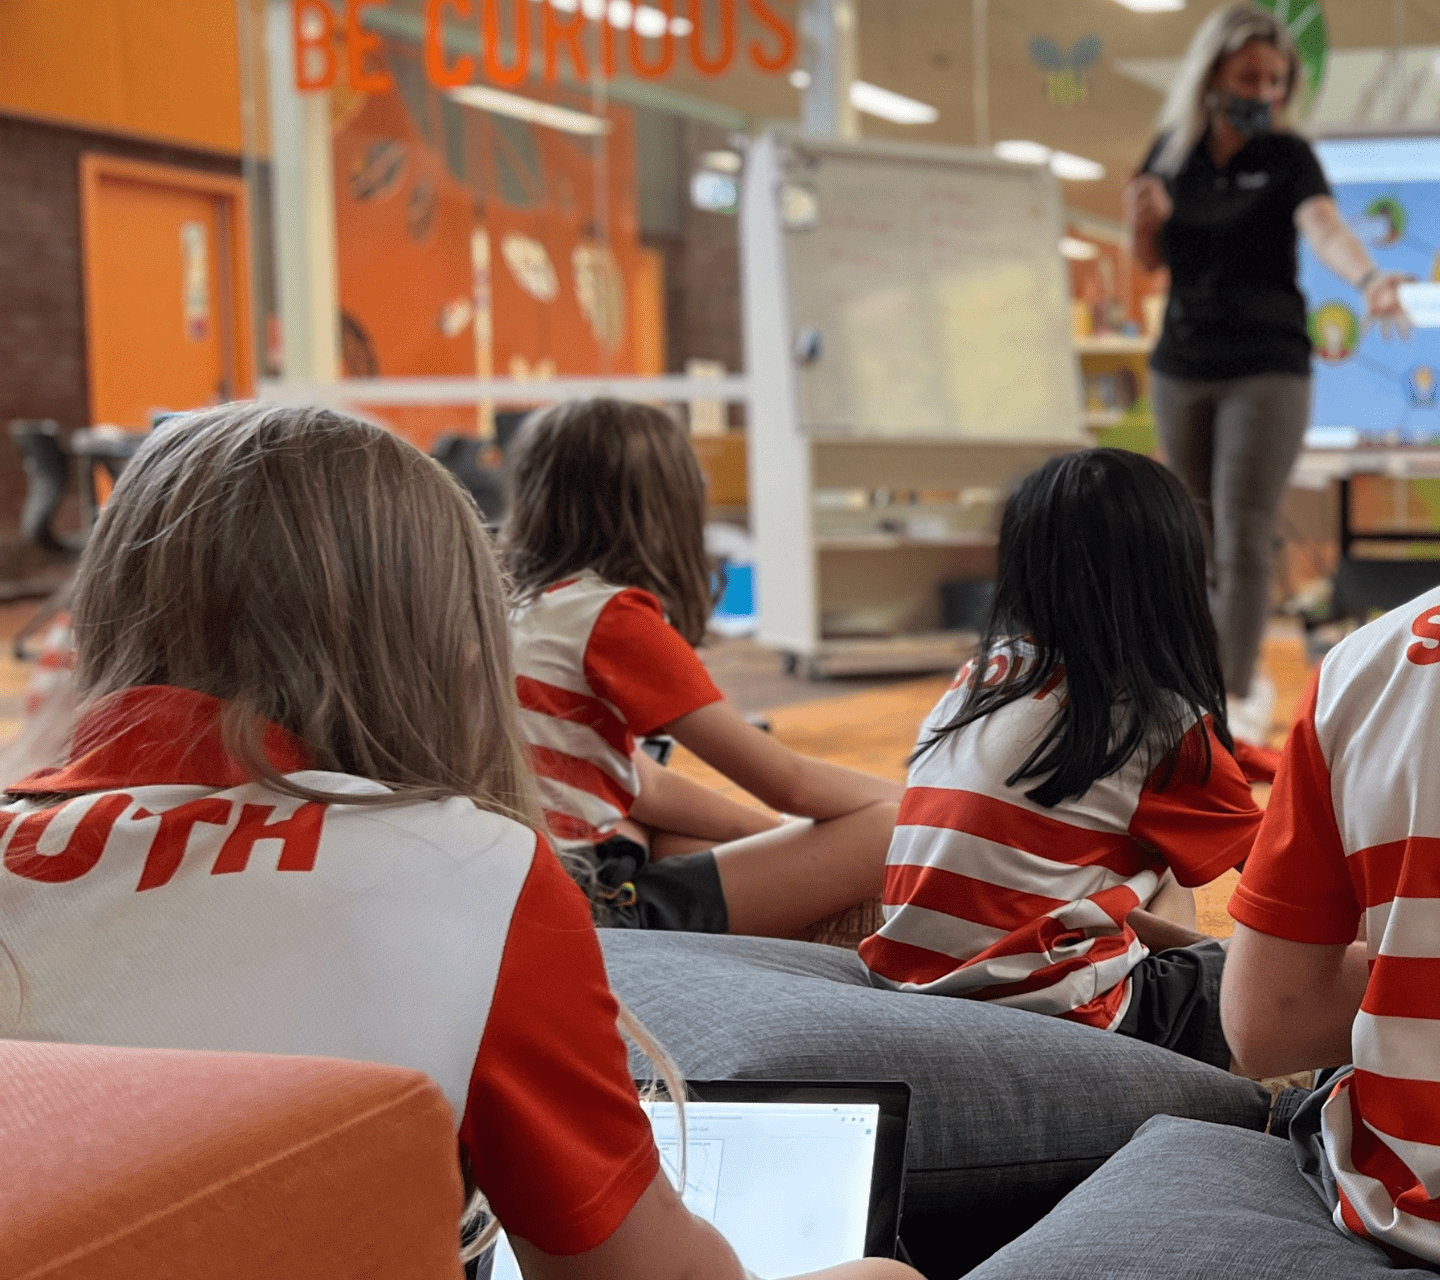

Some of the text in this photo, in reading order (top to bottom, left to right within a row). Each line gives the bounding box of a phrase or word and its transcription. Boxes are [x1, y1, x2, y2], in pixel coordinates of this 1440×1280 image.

[296, 0, 795, 91] BE CURIOUS
[0, 793, 329, 892] UTH
